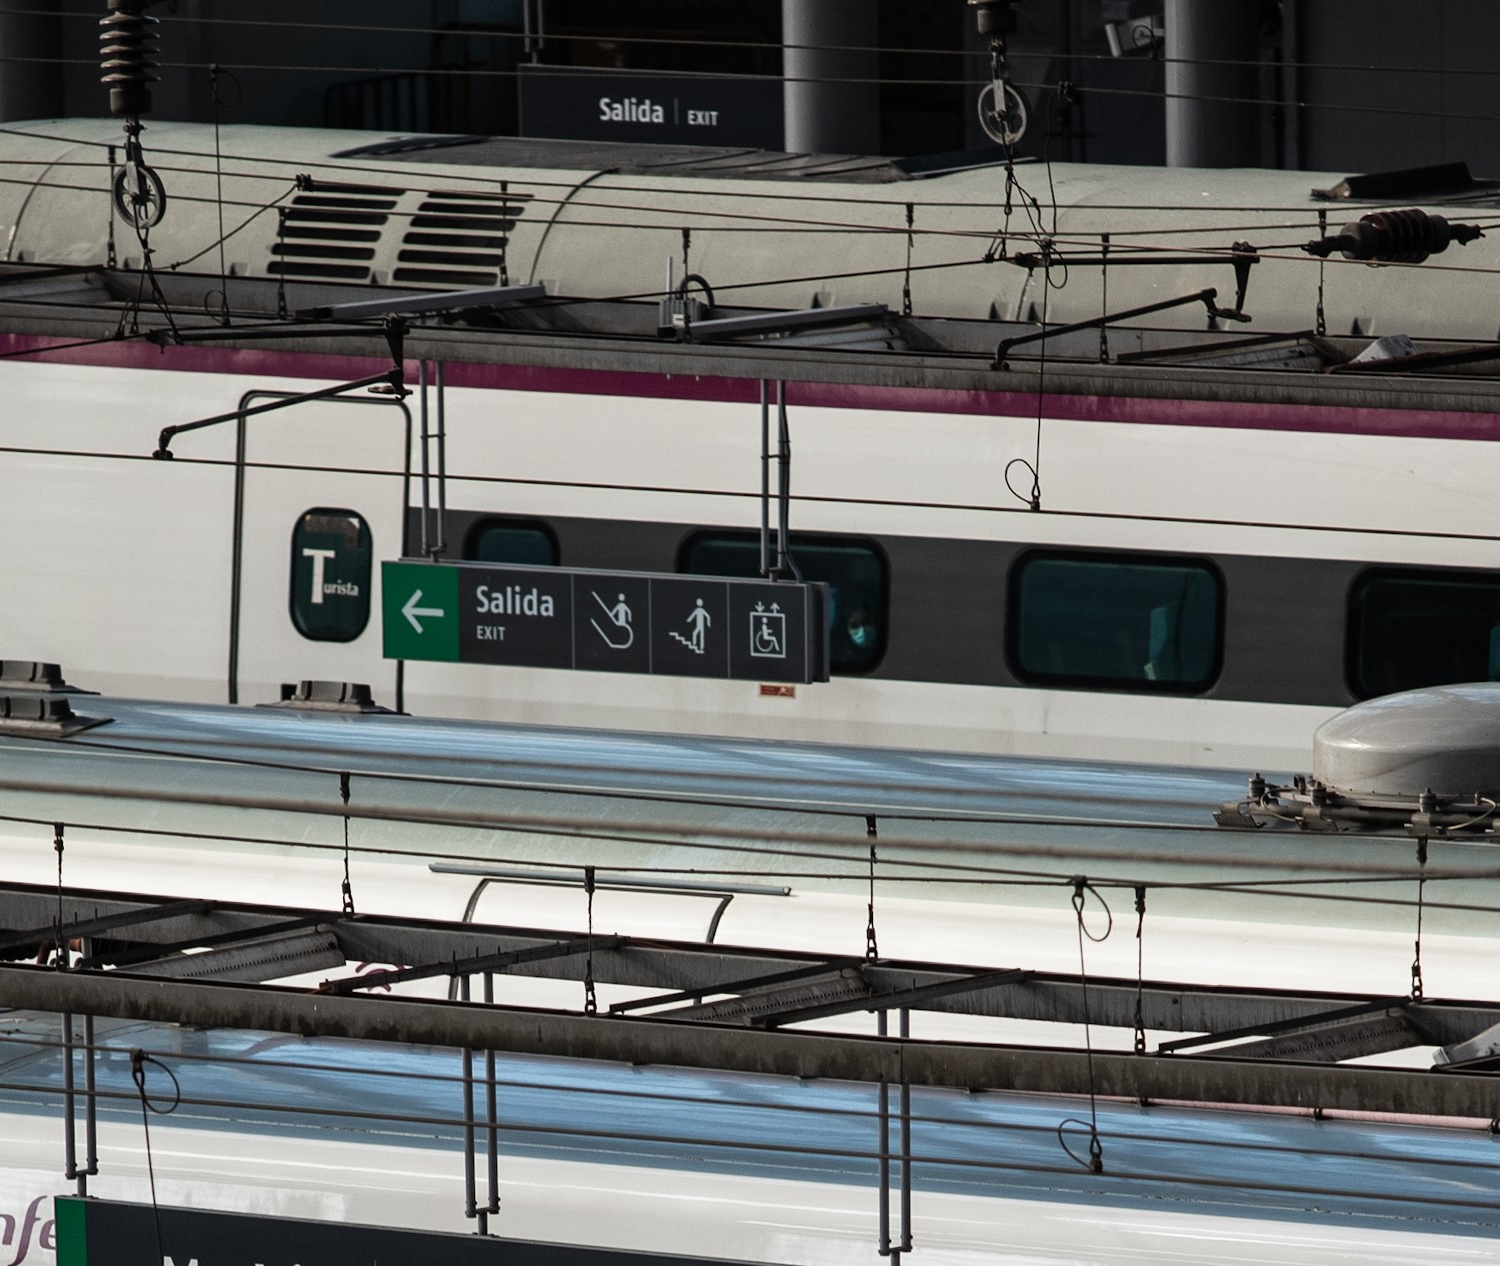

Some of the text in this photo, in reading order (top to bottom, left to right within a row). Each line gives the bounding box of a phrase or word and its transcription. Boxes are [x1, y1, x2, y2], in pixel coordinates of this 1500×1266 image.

[599, 97, 719, 126] Salida EXIT
[302, 548, 359, 604] Turista
[476, 585, 555, 617] Salida
[476, 625, 506, 641] EXIT
